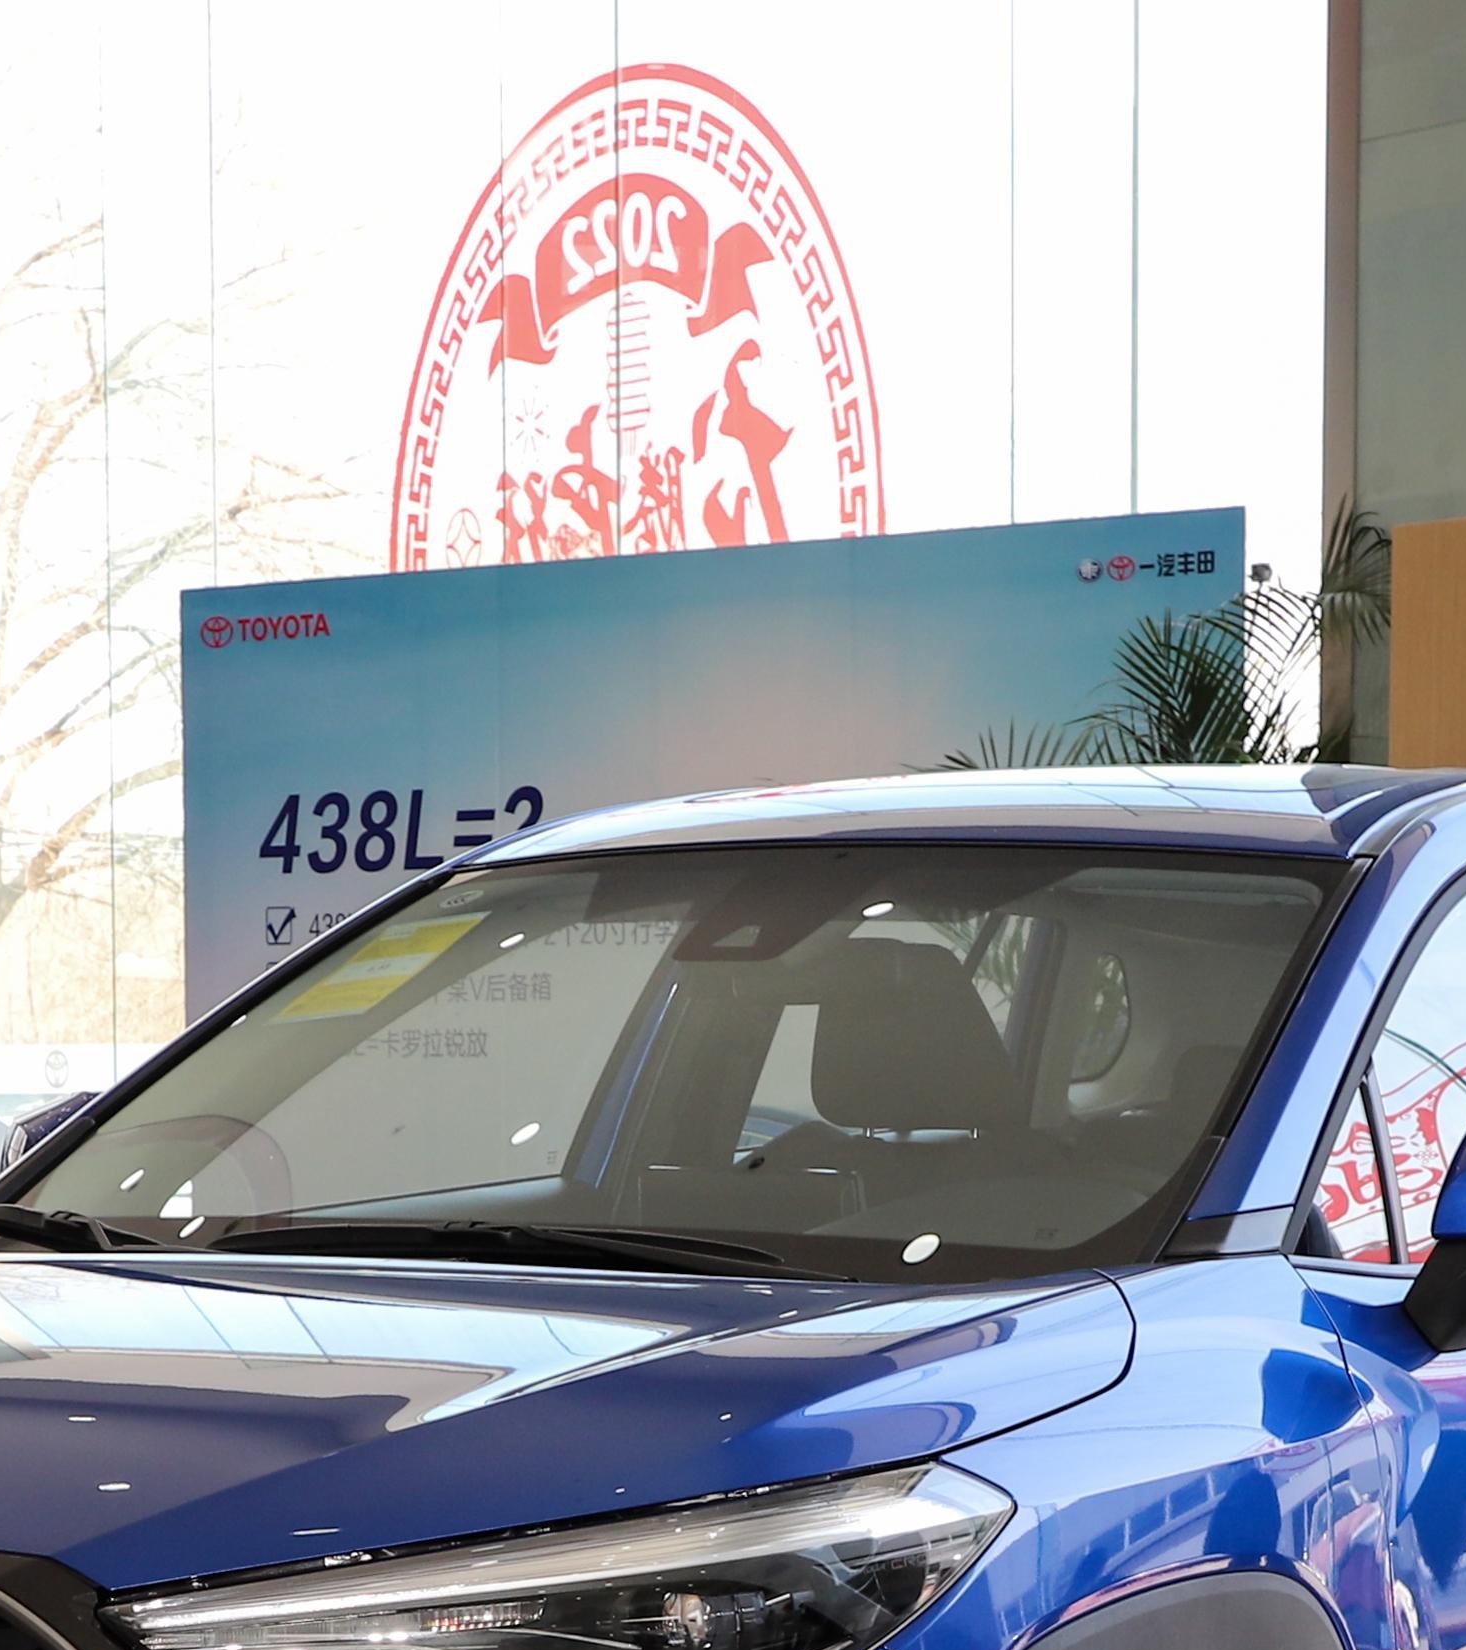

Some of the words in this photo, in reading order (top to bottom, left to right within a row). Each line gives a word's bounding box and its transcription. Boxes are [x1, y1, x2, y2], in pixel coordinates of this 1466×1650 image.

[1139, 550, 1215, 577] 一汽丰田
[237, 612, 330, 642] TOYOTA
[259, 785, 544, 874] 438L=2
[435, 972, 552, 1003] 某V后备箱
